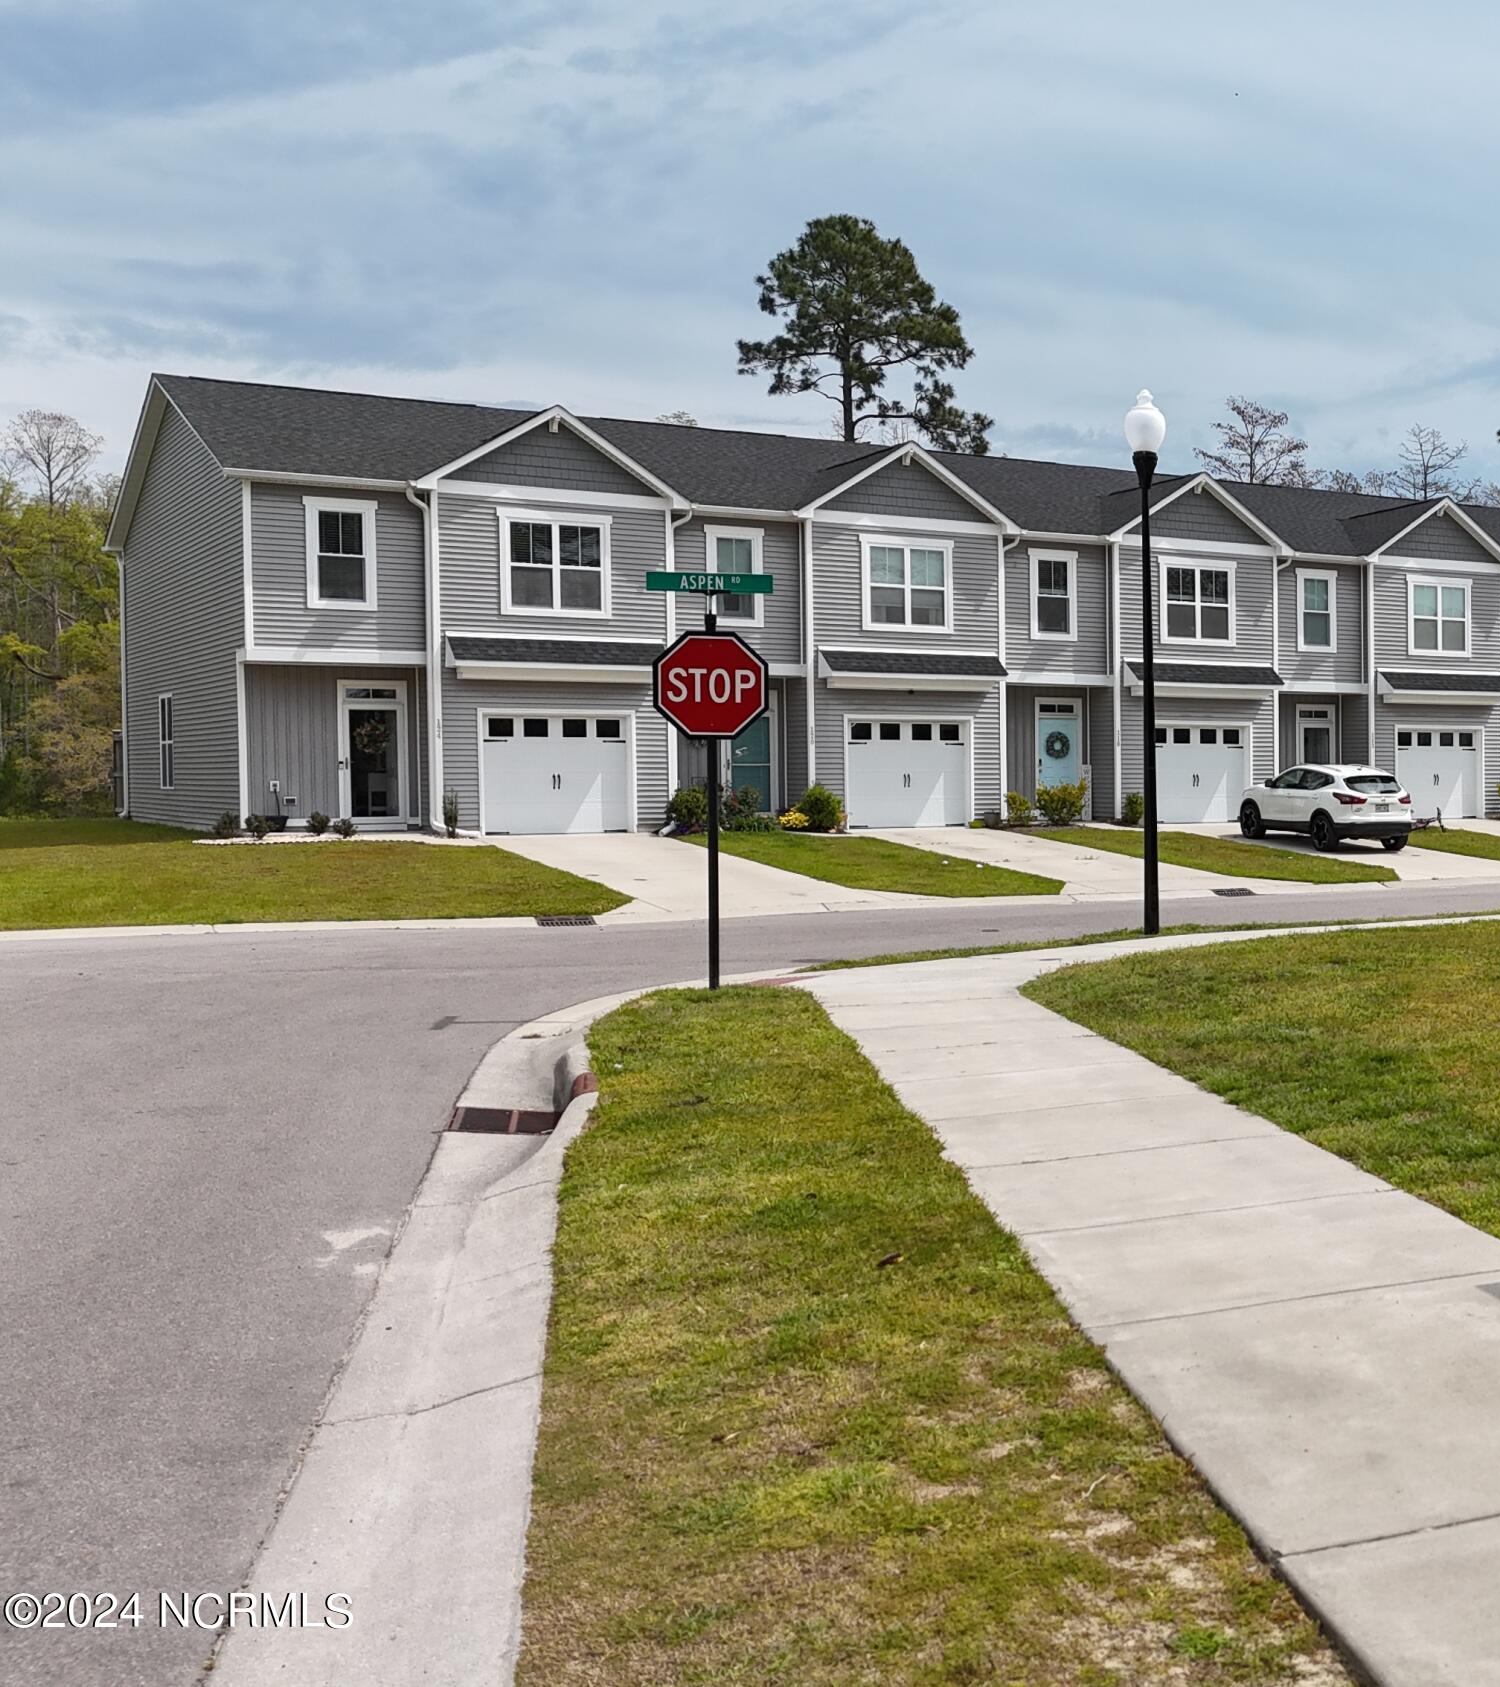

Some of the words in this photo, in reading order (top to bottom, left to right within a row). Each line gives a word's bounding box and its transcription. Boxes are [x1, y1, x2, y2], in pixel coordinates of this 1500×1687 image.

[680, 574, 724, 590] ASPEN
[731, 576, 741, 584] RD
[666, 667, 757, 704] STOP
